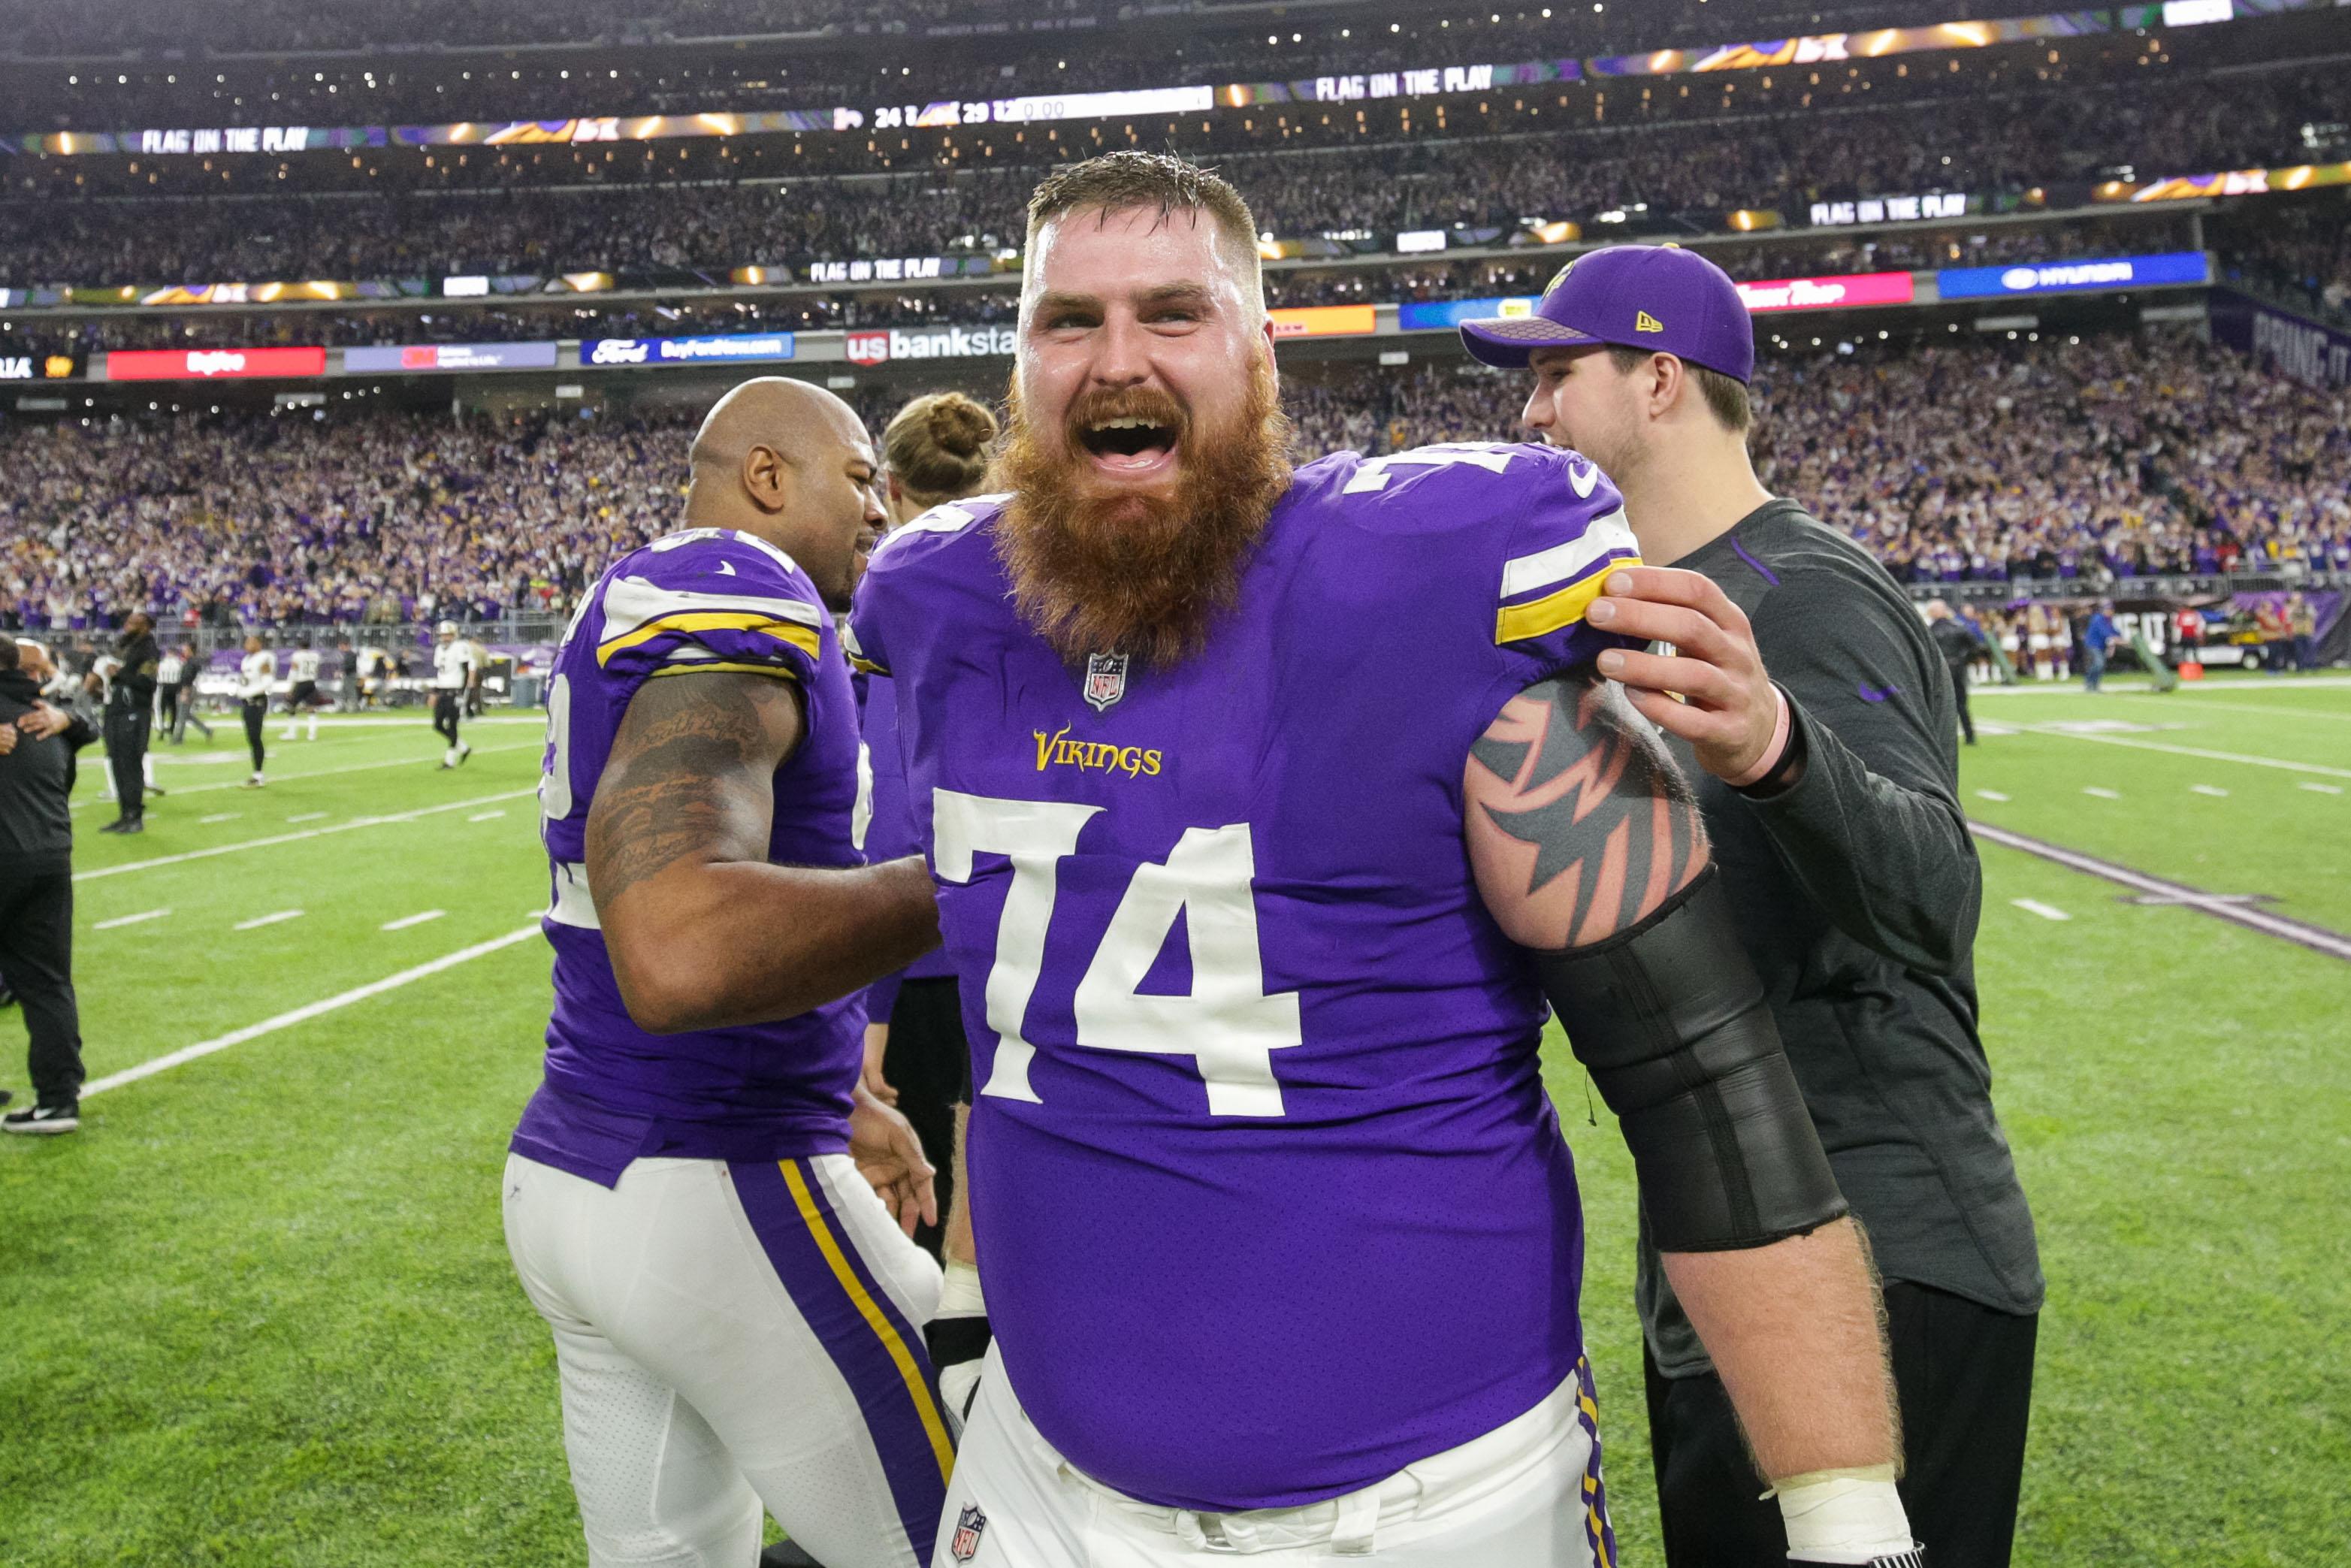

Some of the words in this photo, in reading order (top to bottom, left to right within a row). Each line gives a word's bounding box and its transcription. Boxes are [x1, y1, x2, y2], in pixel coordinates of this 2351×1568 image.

[1316, 76, 1364, 101] FLAG
[1370, 73, 1397, 98] ON
[1403, 69, 1440, 95] THE
[1444, 65, 1492, 92] PLAY
[875, 107, 901, 128] 24
[962, 102, 989, 123] 29
[143, 129, 189, 153] FLAG
[194, 128, 221, 153] ON
[225, 128, 259, 152] THE
[263, 126, 309, 151] PLAY
[1811, 202, 1854, 225] FLAG
[1887, 197, 1920, 220] THE
[1922, 193, 1966, 218] PLAY
[811, 262, 847, 282] FLAG
[850, 261, 871, 280] ON
[875, 259, 902, 279] THE
[905, 258, 940, 278] PLAY
[2039, 262, 2133, 286] HYUNDAI
[591, 339, 648, 364] Ford
[1091, 675, 1118, 698] NFL
[933, 787, 1302, 1117] 74
[953, 1528, 975, 1555] NFL
